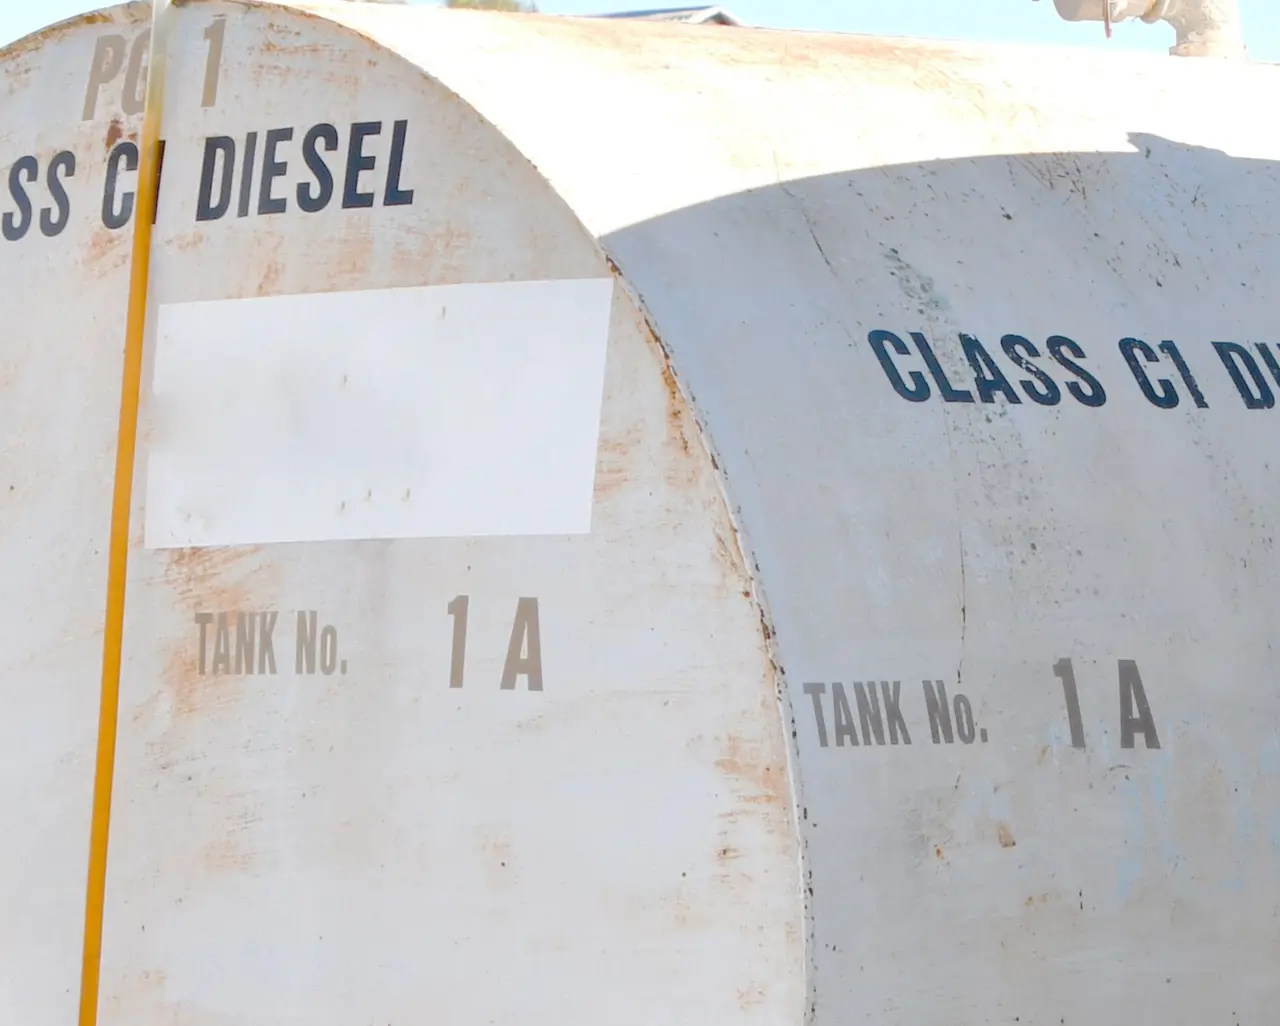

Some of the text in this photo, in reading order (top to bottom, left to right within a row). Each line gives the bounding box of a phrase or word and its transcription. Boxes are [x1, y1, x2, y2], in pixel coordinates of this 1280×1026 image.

[201, 18, 226, 107] 1
[196, 119, 414, 222] DIESEL
[867, 329, 1107, 408] CLASS
[1119, 337, 1209, 410] C1
[195, 594, 543, 692] TANK No. 1 A
[803, 657, 1161, 749] TANK No. 1 A
